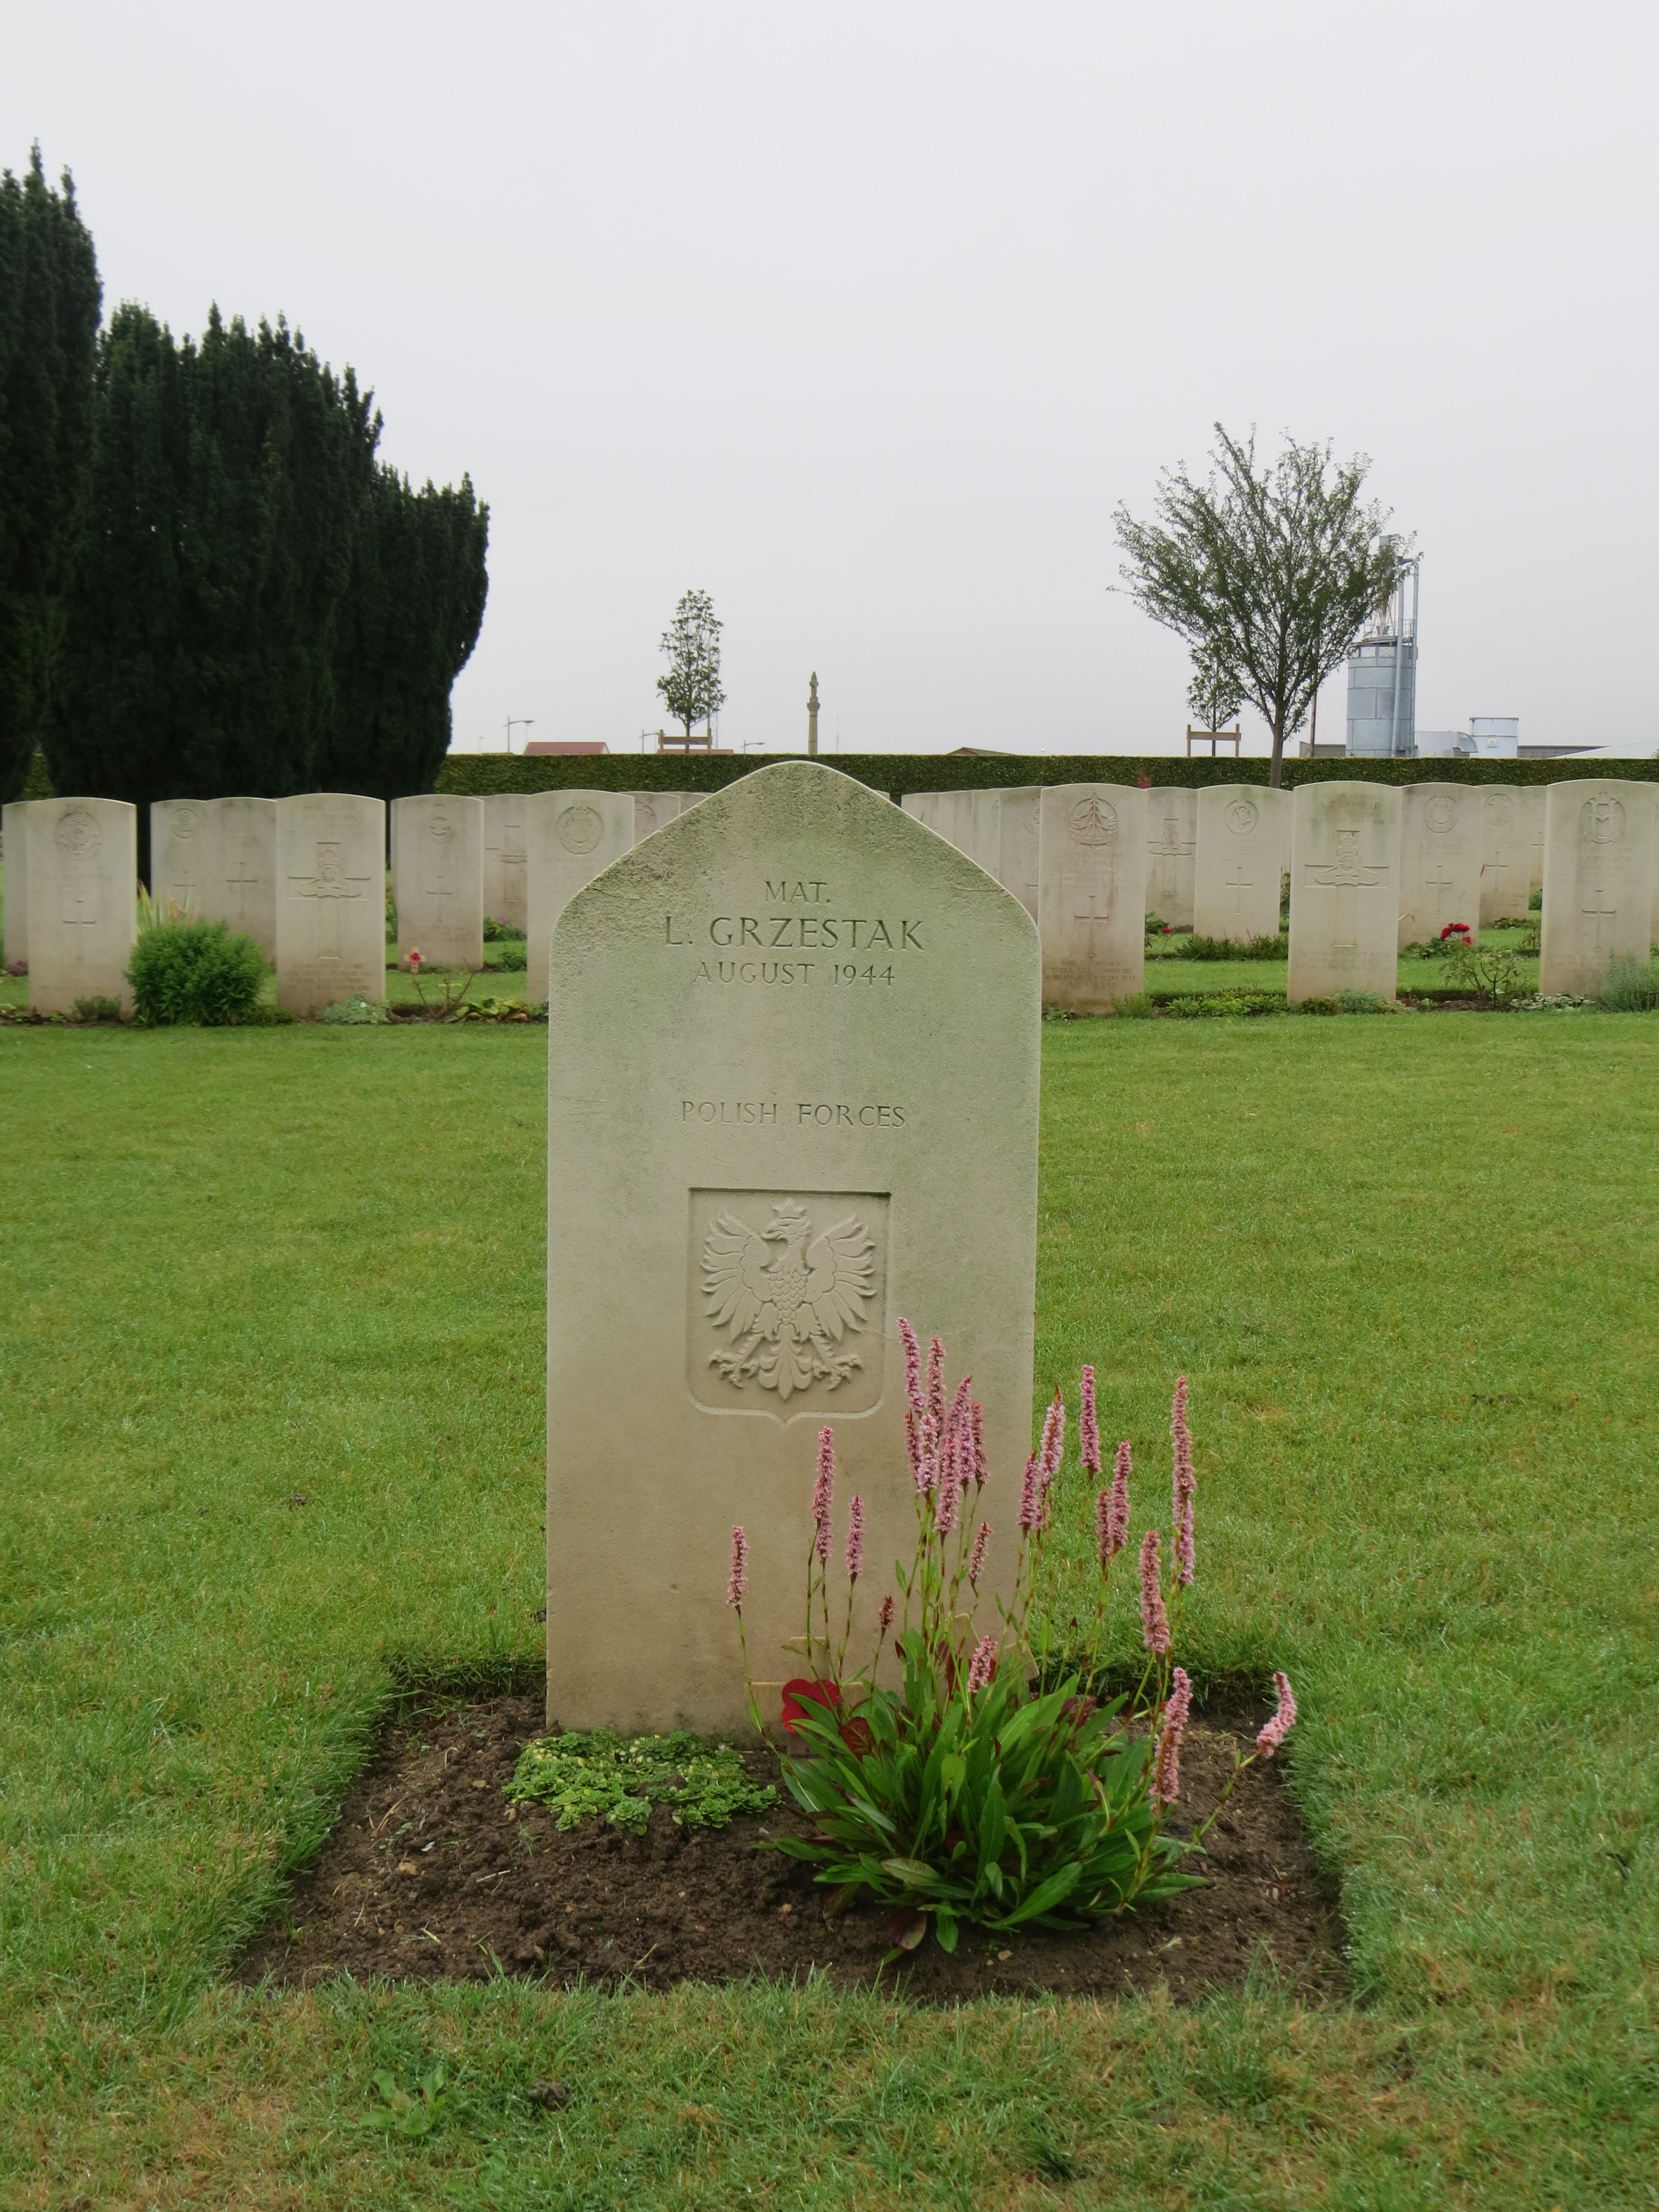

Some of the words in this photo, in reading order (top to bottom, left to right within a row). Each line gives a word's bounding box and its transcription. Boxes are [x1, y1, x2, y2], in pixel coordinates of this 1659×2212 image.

[764, 880, 831, 904] MAT.
[664, 916, 693, 947] L.
[709, 916, 926, 951] GRZESTAK
[692, 961, 815, 985] AUGUST
[832, 964, 895, 988] 1944
[681, 1100, 778, 1125] POLISH
[796, 1103, 906, 1128] FORCES
